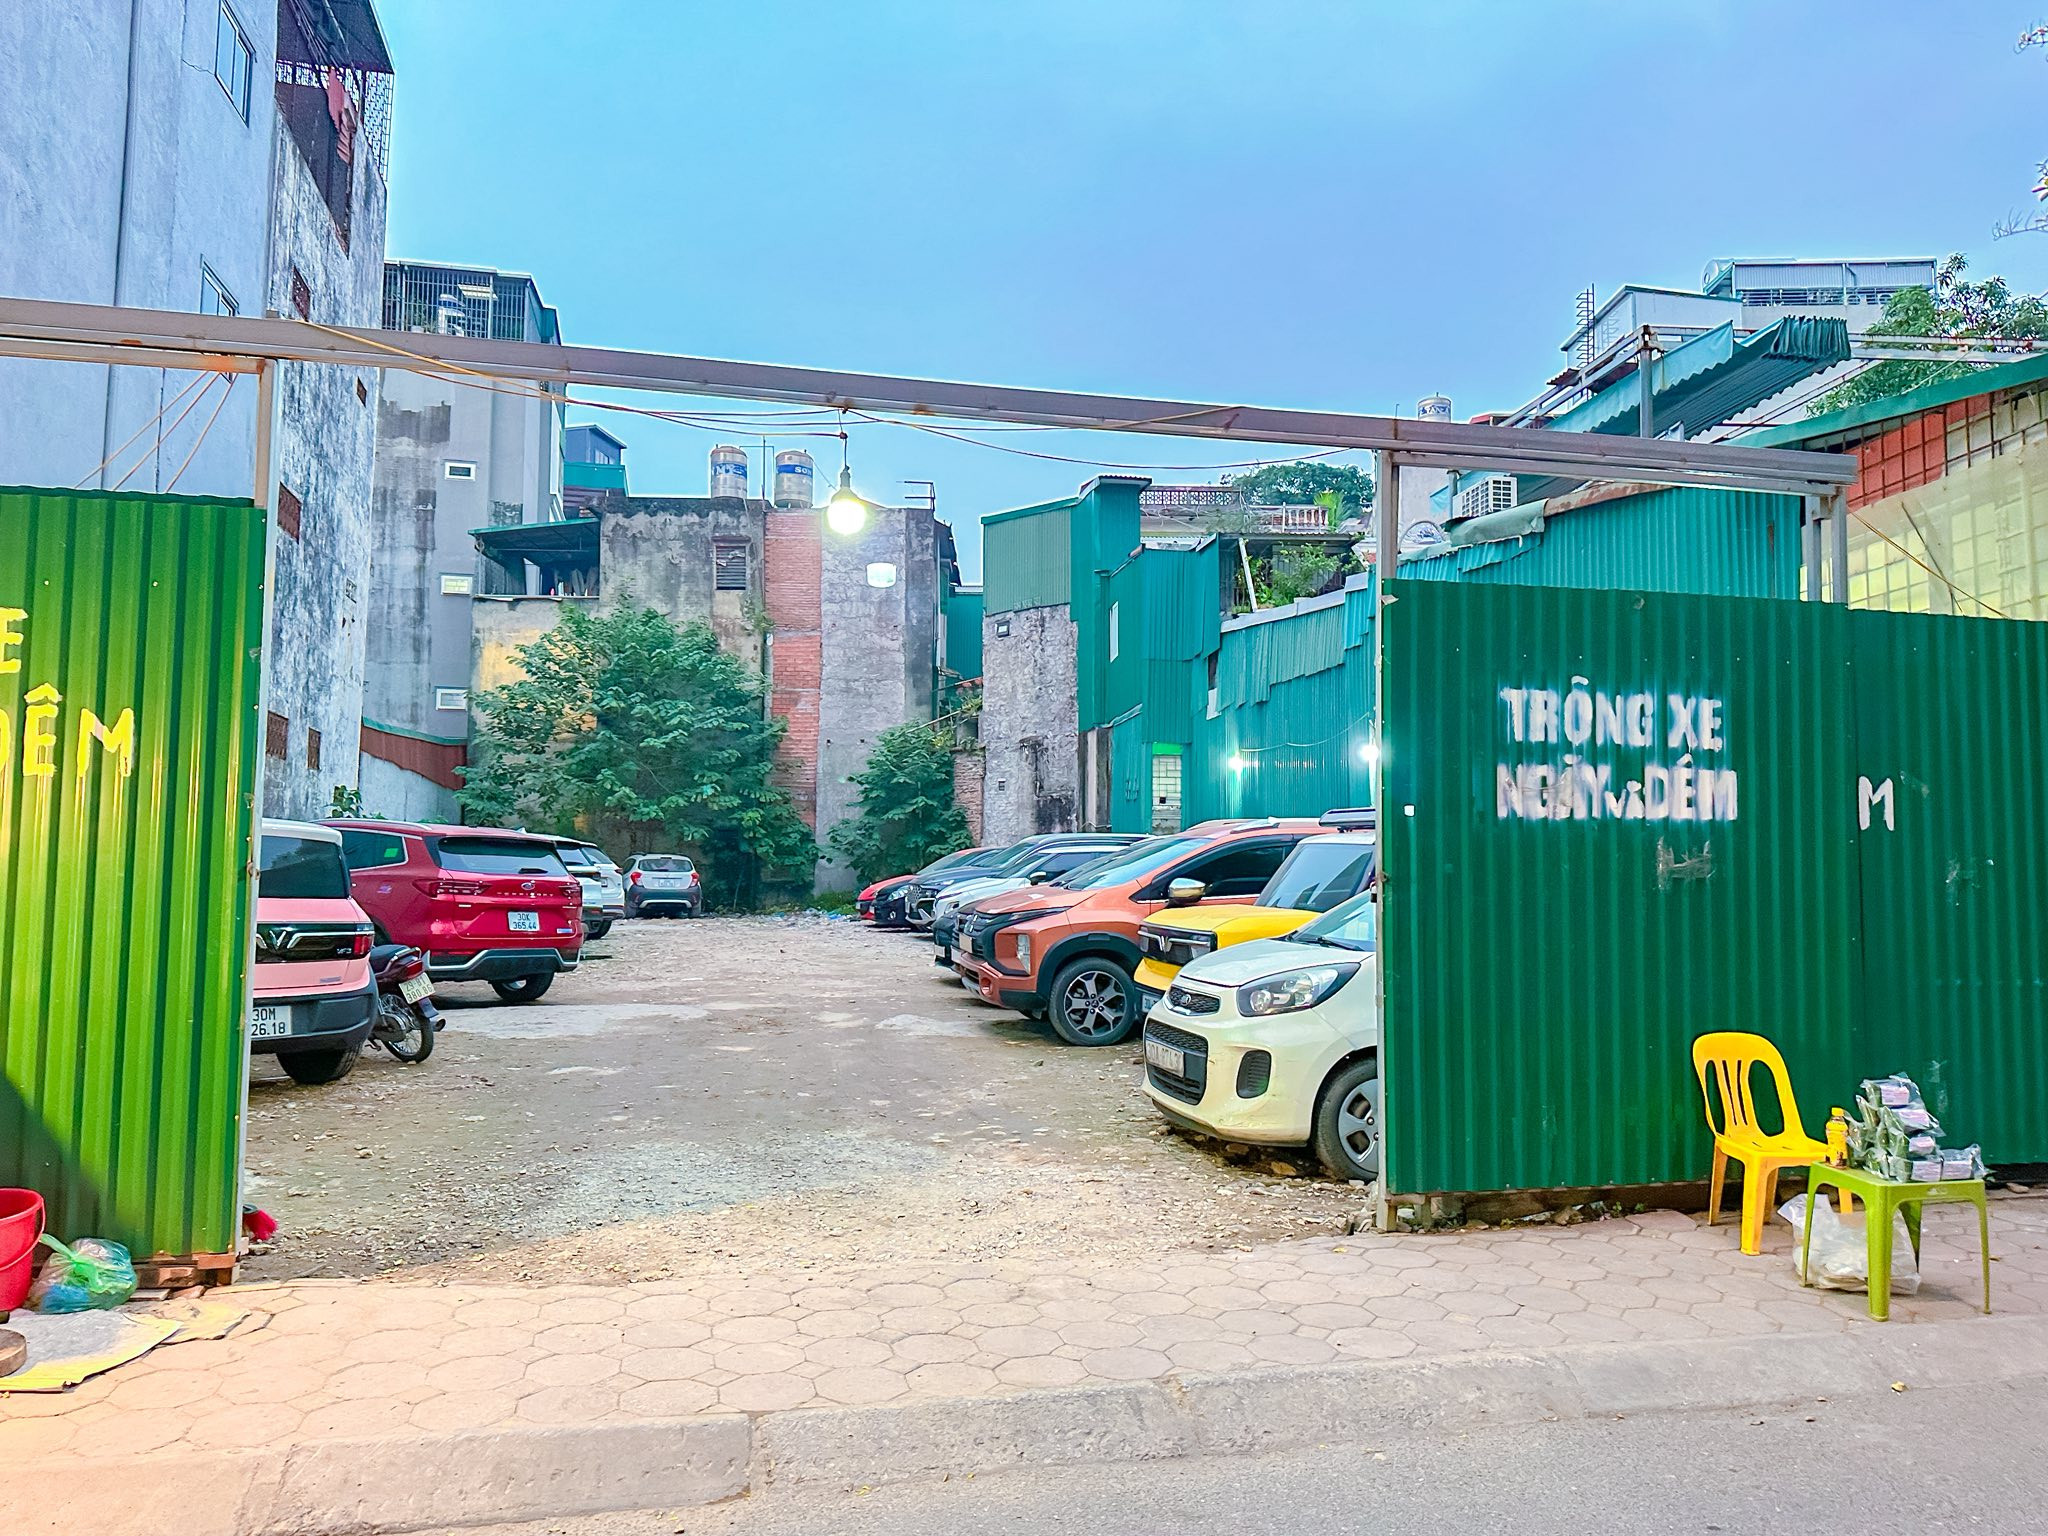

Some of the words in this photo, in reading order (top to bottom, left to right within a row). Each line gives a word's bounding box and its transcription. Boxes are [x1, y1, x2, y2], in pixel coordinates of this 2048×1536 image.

[1667, 693, 1723, 752] XE
[1858, 775, 1896, 832] M
[252, 1007, 276, 1021] 30M
